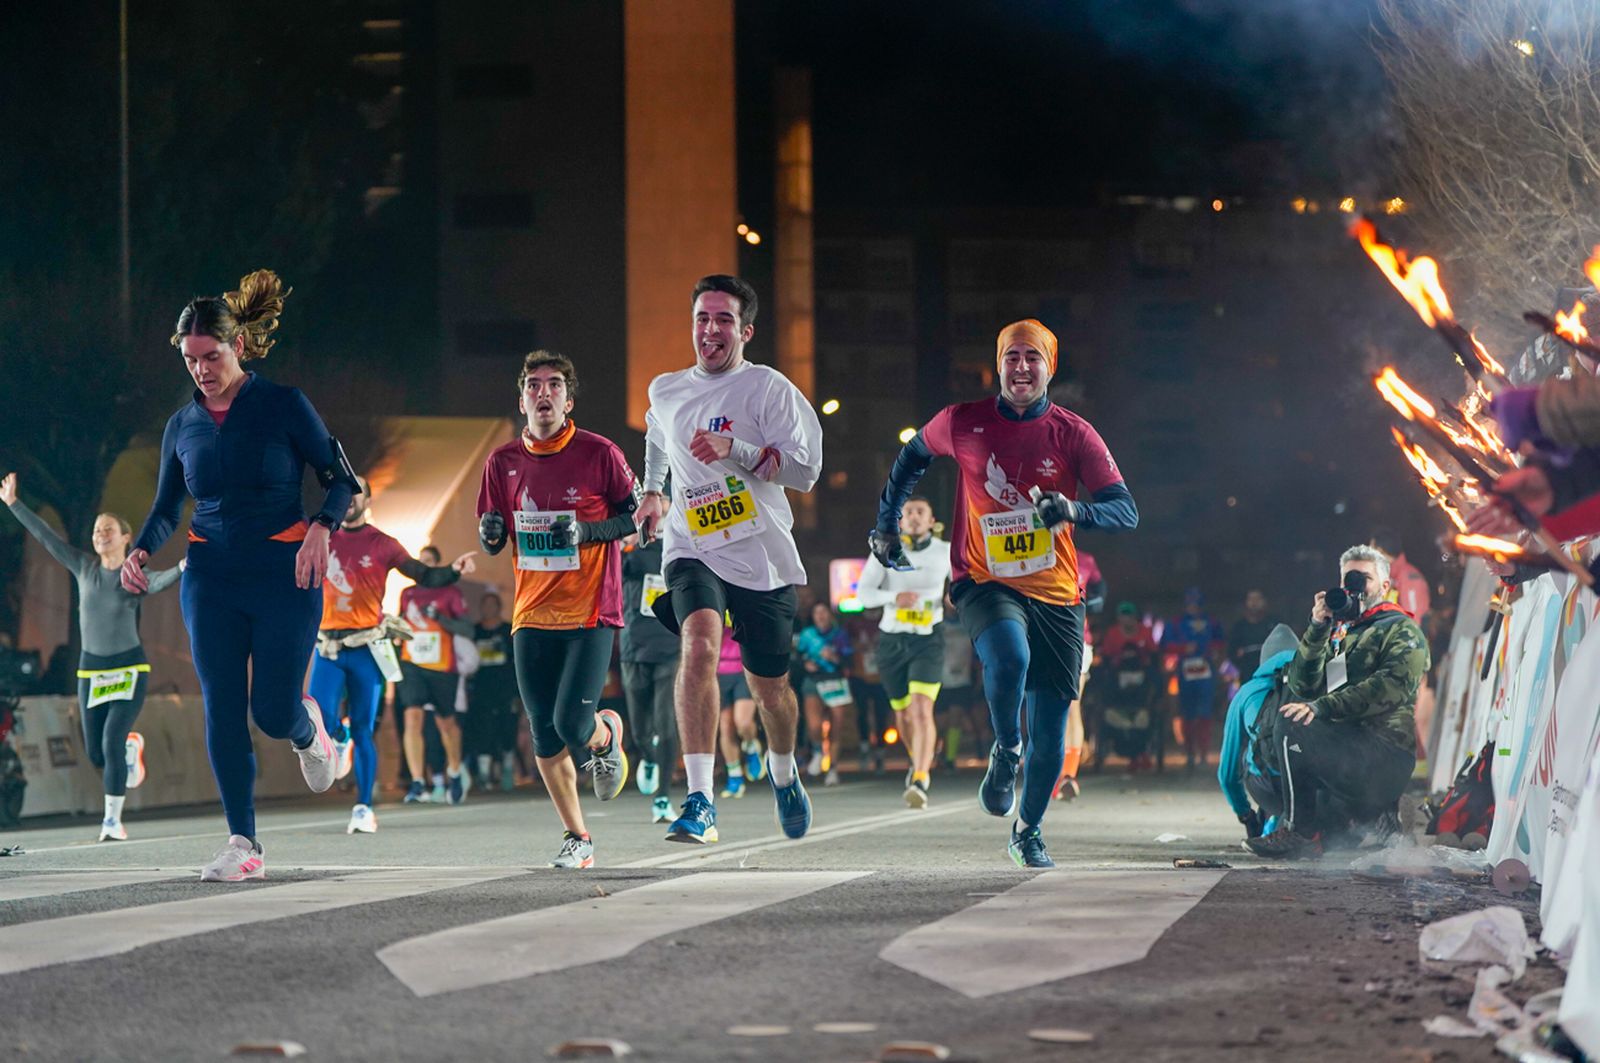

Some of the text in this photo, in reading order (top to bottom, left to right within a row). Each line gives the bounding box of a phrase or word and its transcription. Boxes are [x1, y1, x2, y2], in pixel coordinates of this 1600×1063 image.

[693, 486, 712, 497] NOCHE
[1000, 488, 1019, 506] 43
[689, 498, 702, 508] SAN
[696, 495, 744, 528] 3266
[995, 517, 1016, 527] NOCHE
[1018, 515, 1026, 525] DE
[990, 527, 1003, 535] SAN
[1004, 532, 1035, 554] 447
